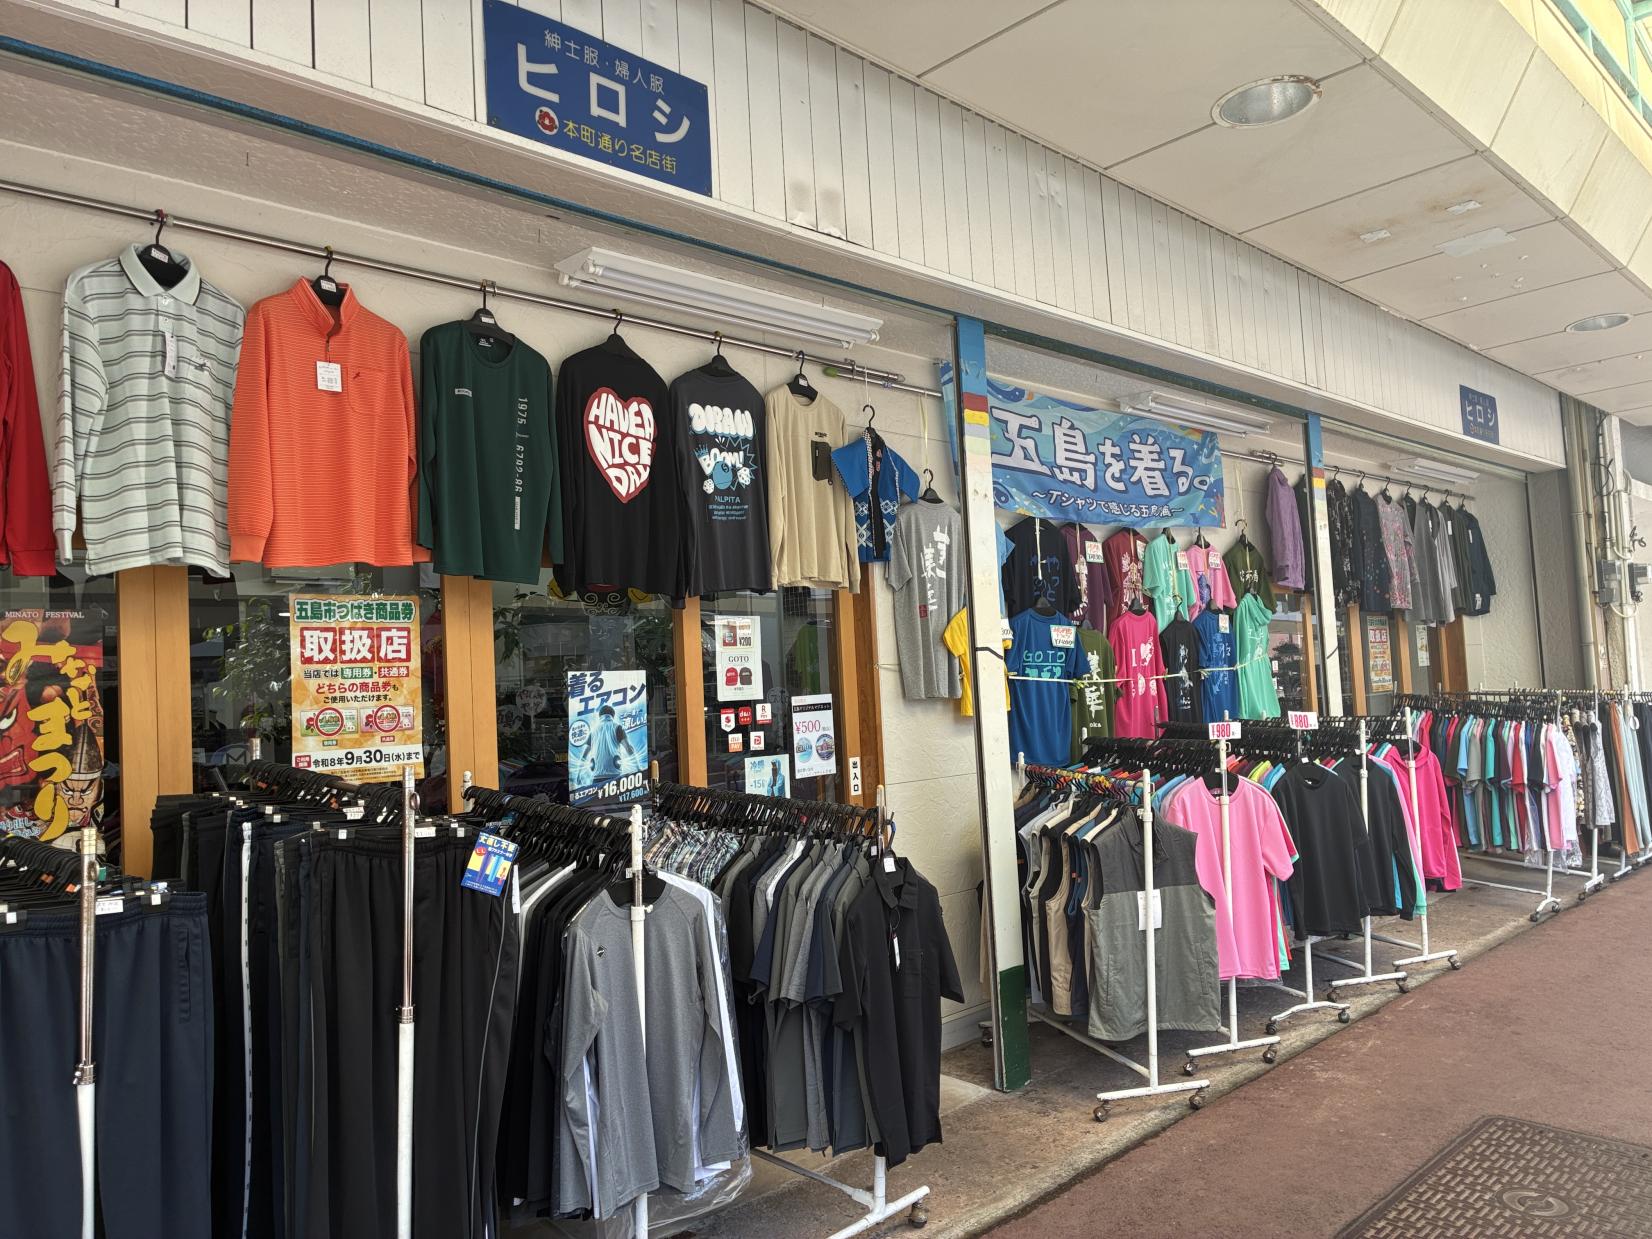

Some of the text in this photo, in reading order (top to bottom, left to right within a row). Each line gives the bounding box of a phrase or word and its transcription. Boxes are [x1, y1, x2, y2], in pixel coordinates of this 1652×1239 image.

[543, 28, 665, 95] 紳士服・婦人服
[516, 42, 690, 143] ヒロシ
[563, 119, 677, 175] 本町通り名店街
[1465, 400, 1495, 426] ヒロシ
[588, 424, 653, 469] NICE
[991, 407, 1212, 497] 五島を着る。
[605, 464, 651, 498] DAY
[295, 600, 416, 622] 五島市つばき商品券
[302, 629, 408, 662] 取扱店
[728, 655, 749, 663] GOTO
[315, 681, 399, 695] どちらの商品券も
[569, 672, 605, 699] 着る
[577, 683, 646, 716] エアコン
[795, 720, 821, 733] ¥500
[1211, 724, 1231, 738] ¥980
[1291, 714, 1309, 729] ¥880
[598, 772, 643, 798] ¥16,000
[851, 760, 860, 792] 出入口
